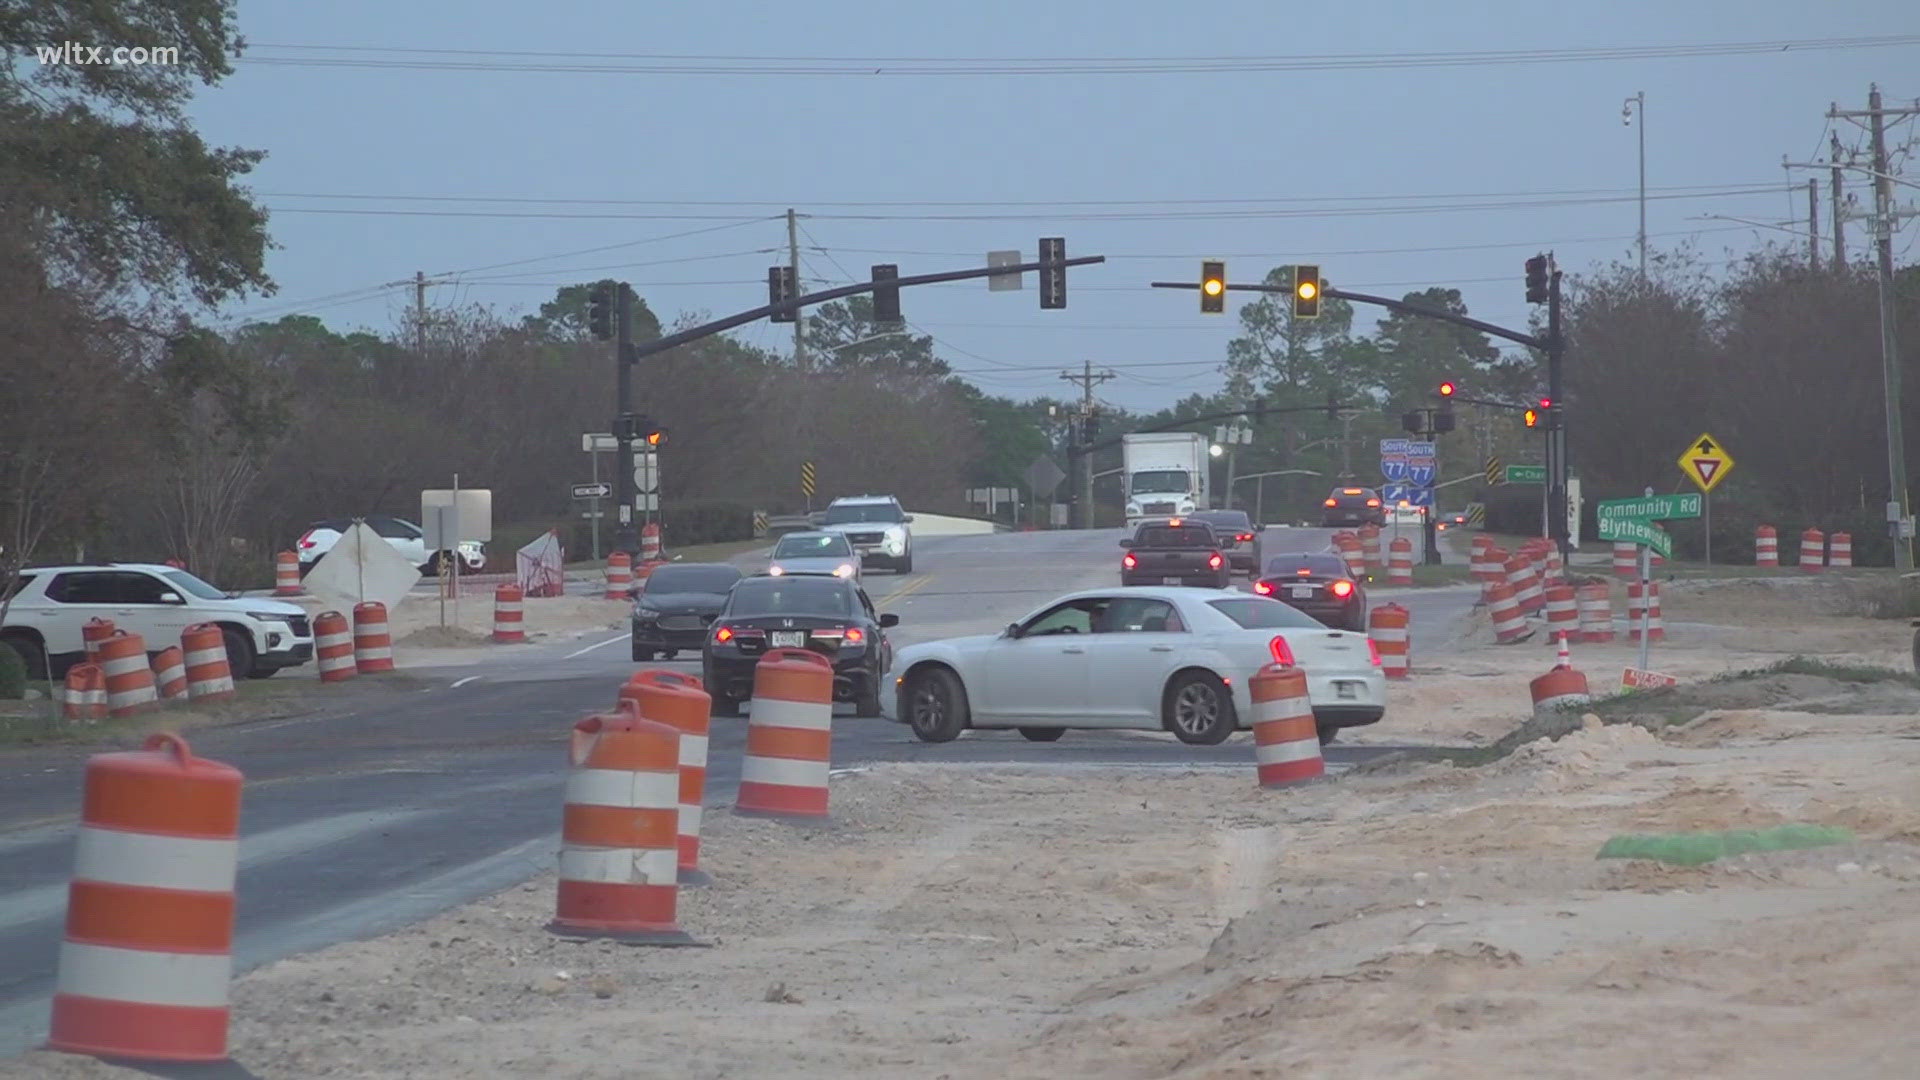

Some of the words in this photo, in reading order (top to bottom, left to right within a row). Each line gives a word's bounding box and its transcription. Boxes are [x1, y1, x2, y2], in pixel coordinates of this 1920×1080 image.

[1408, 444, 1434, 455] SOUTH
[1385, 462, 1405, 476] 77
[1411, 466, 1430, 480] 77
[1598, 499, 1672, 518] Community
[1681, 498, 1697, 513] Rd
